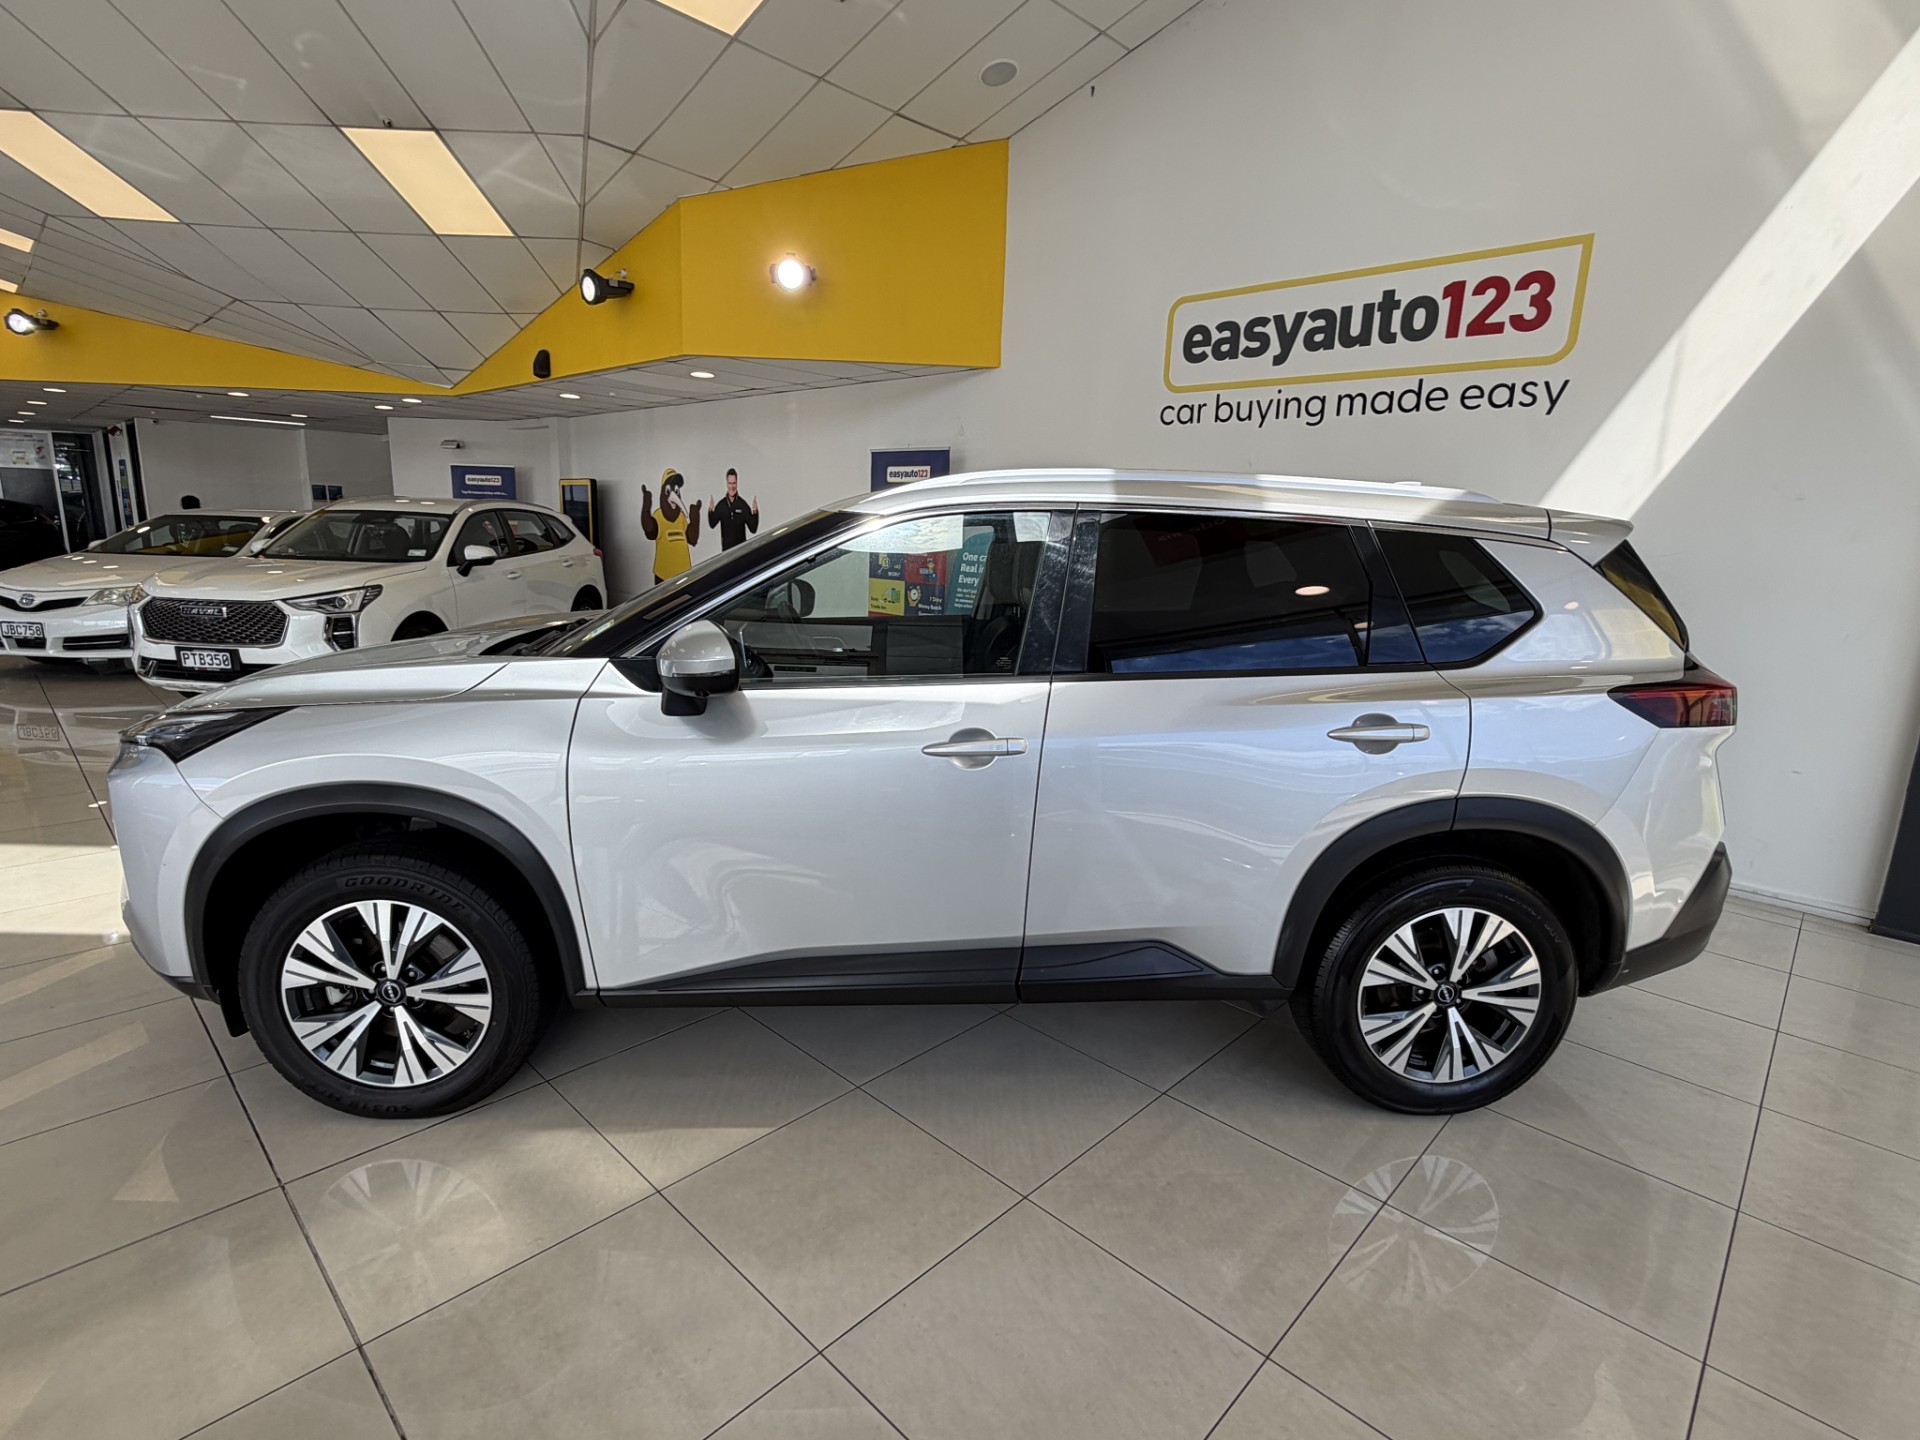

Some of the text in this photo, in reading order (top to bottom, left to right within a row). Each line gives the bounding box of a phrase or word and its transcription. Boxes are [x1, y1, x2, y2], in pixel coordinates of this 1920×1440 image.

[1183, 270, 1556, 367] easyauto123
[1159, 379, 1570, 428] car buying made easy
[889, 469, 928, 480] easyauto123
[962, 552, 978, 562] One
[960, 563, 978, 573] Real
[958, 574, 979, 587] Every
[3, 624, 42, 636] JBC758
[182, 652, 230, 667] PTB350
[345, 876, 466, 911] GOODRIDE
